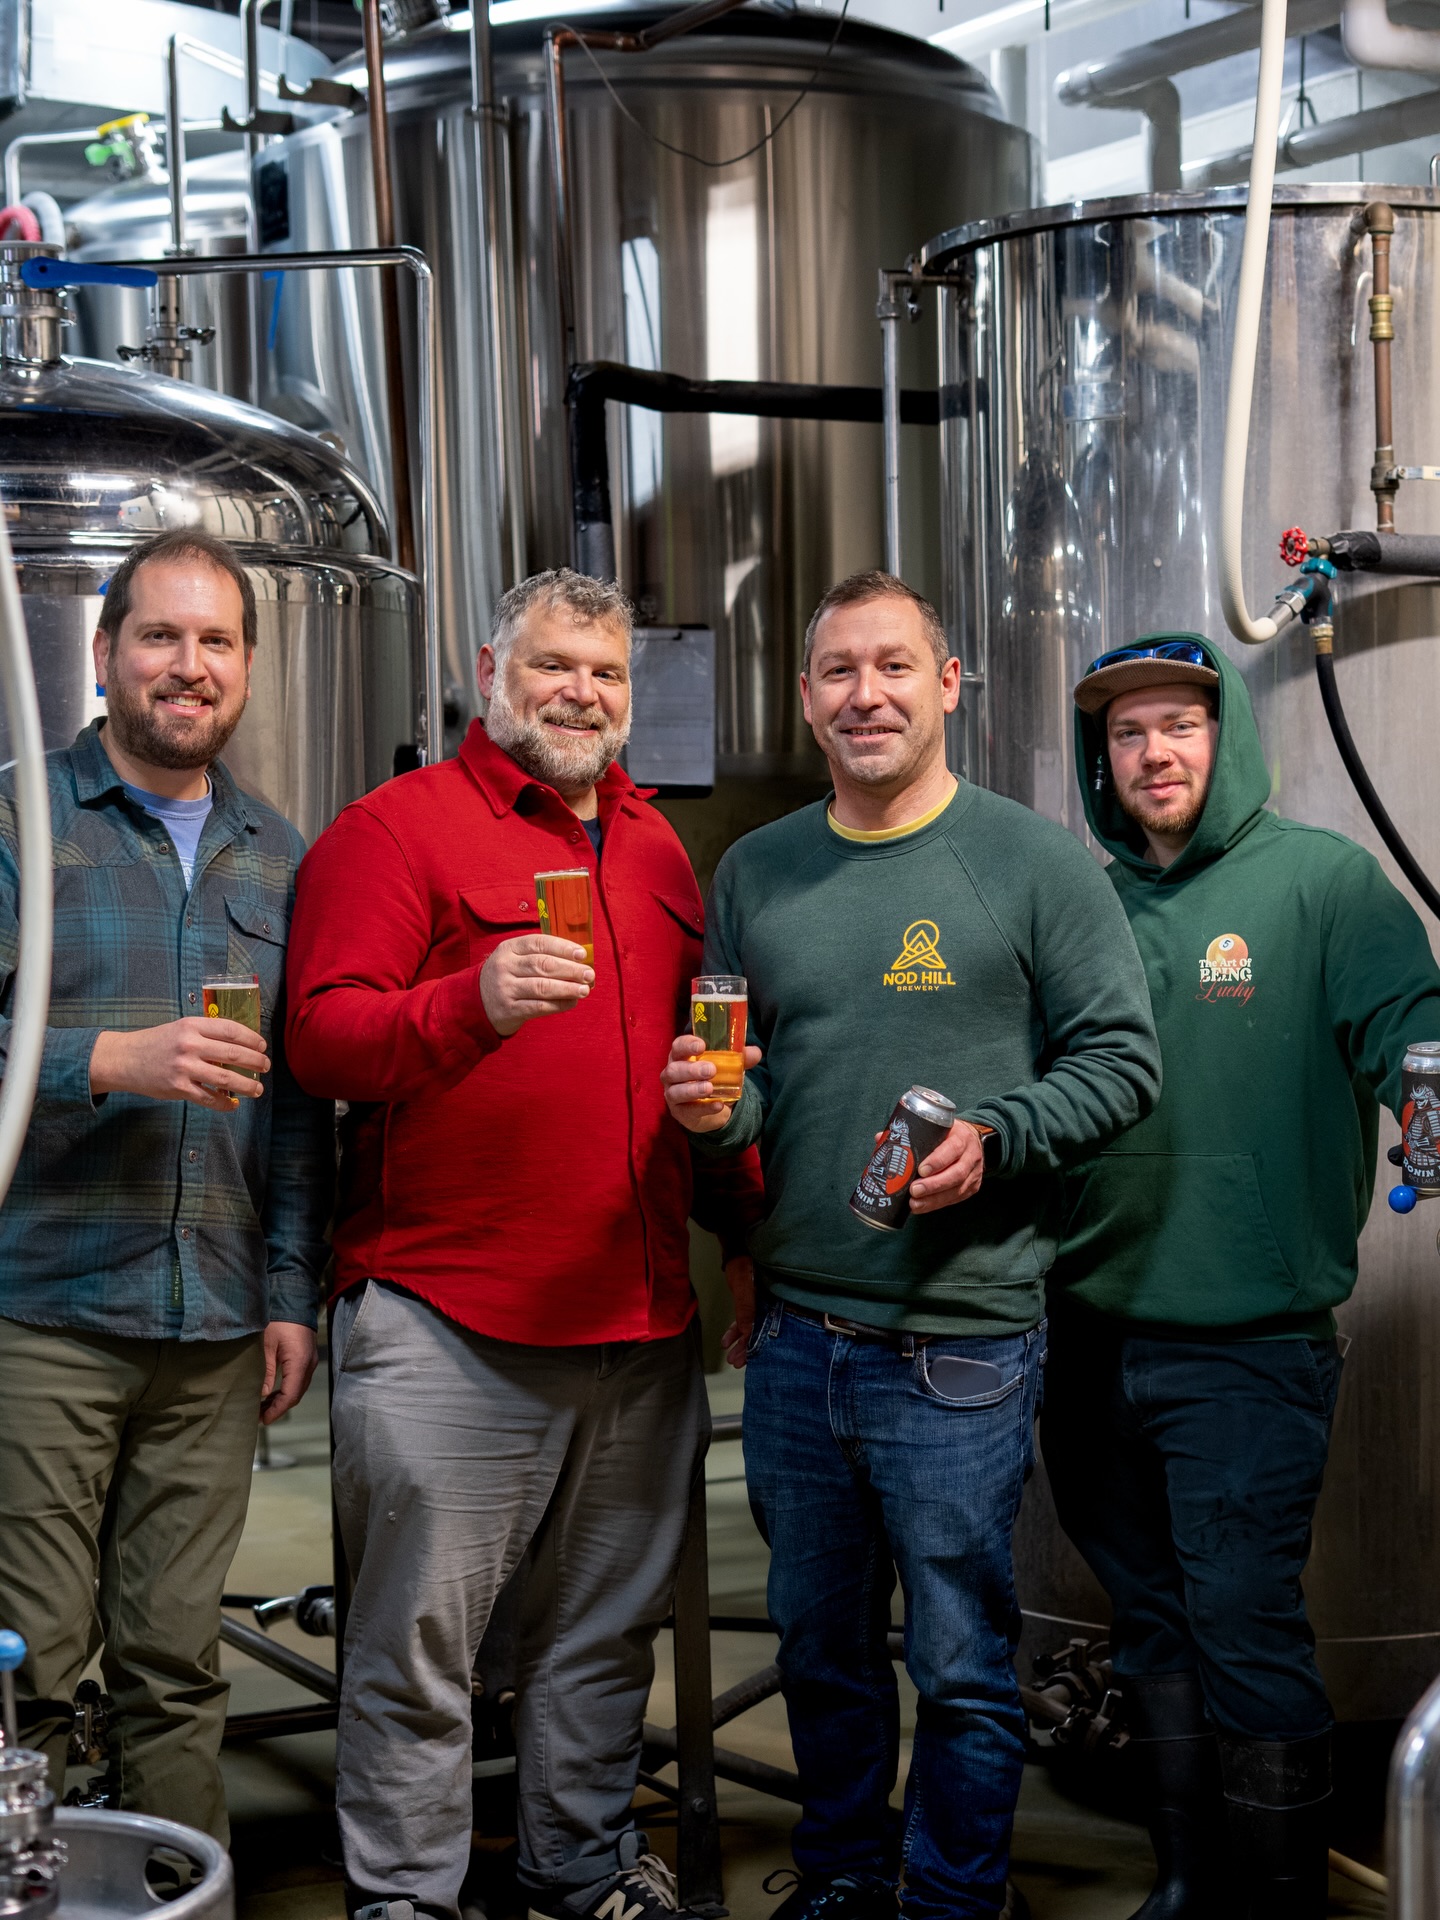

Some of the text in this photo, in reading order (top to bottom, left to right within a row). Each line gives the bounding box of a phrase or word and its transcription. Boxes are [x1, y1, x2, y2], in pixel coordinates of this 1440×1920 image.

[1222, 939, 1231, 949] 5
[1199, 957, 1253, 969] The Art Of
[883, 971, 956, 986] NOD HILL
[1199, 967, 1253, 983] BEING
[1195, 977, 1256, 1008] Lucky
[1403, 1156, 1434, 1177] RONIN
[855, 1182, 875, 1206] ONIN
[878, 1196, 892, 1208] 51
[593, 1889, 645, 1920] N
